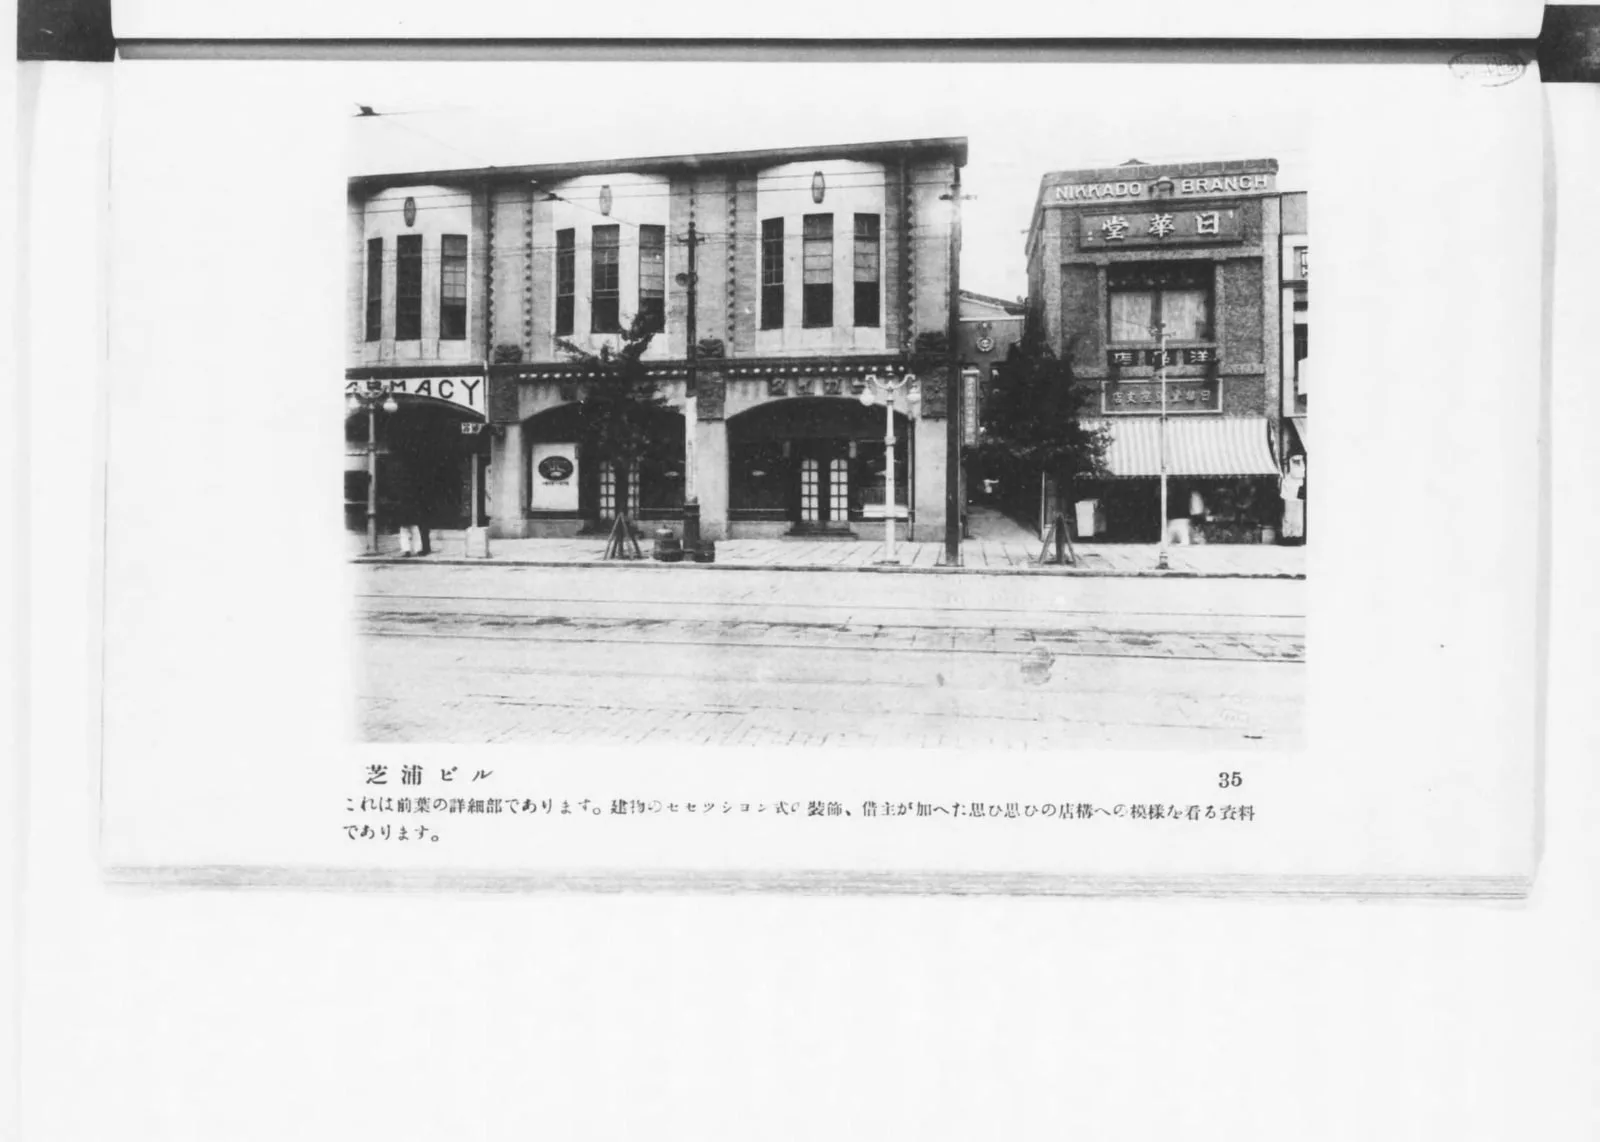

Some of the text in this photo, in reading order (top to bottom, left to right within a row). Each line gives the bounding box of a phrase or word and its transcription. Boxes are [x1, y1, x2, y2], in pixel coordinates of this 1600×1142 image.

[1055, 174, 1268, 200] NIKKADO BRANCH
[1219, 772, 1243, 788] 35
[343, 824, 439, 842] であります。
